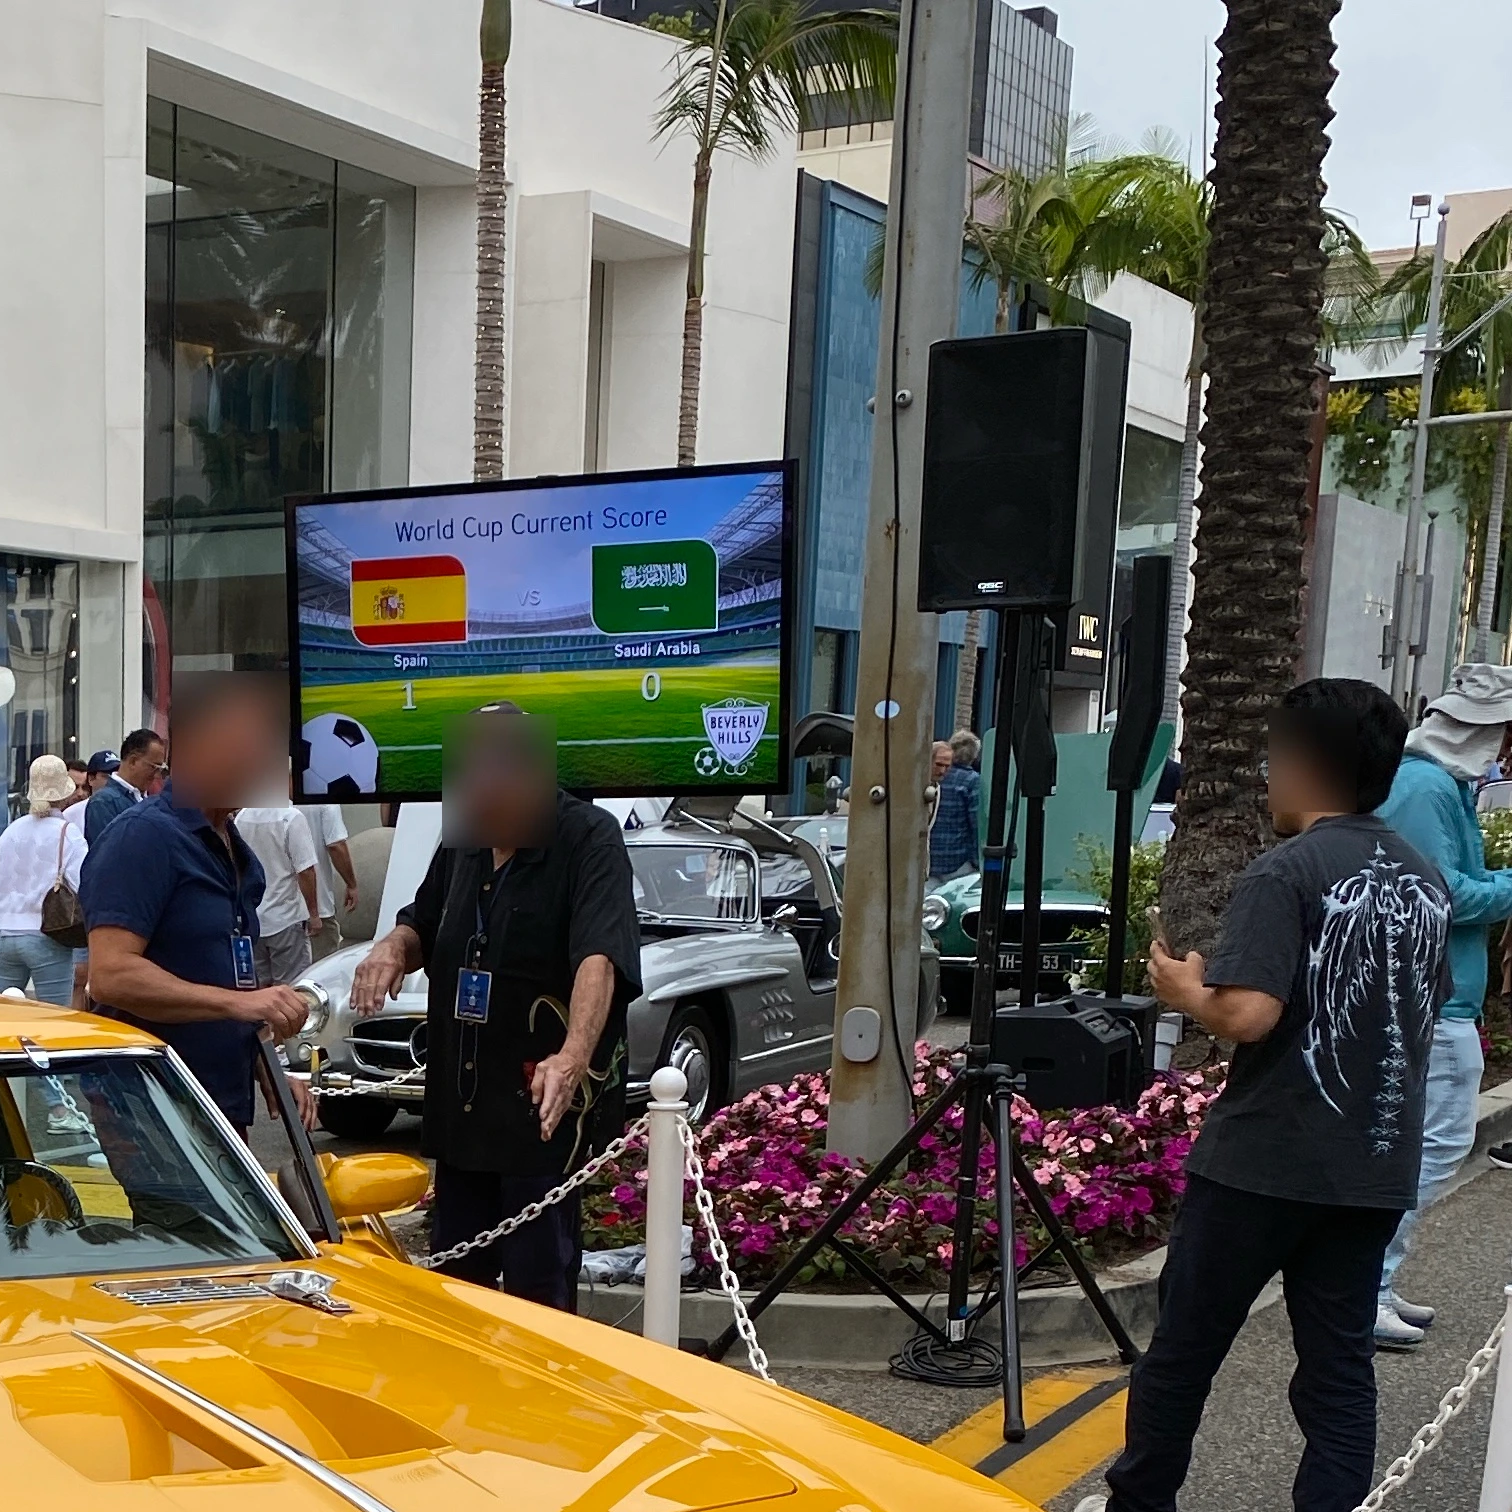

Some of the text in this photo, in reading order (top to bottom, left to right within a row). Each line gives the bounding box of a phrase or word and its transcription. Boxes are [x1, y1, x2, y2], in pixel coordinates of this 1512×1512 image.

[395, 506, 668, 543] World Cup Current Score
[1078, 614, 1099, 642] IWC
[614, 640, 701, 659] Saudi Arabia
[393, 653, 428, 670] Spain
[401, 682, 417, 710] 1
[640, 672, 661, 702] 0
[710, 716, 760, 731] BEVERLY
[718, 730, 752, 746] HILLS
